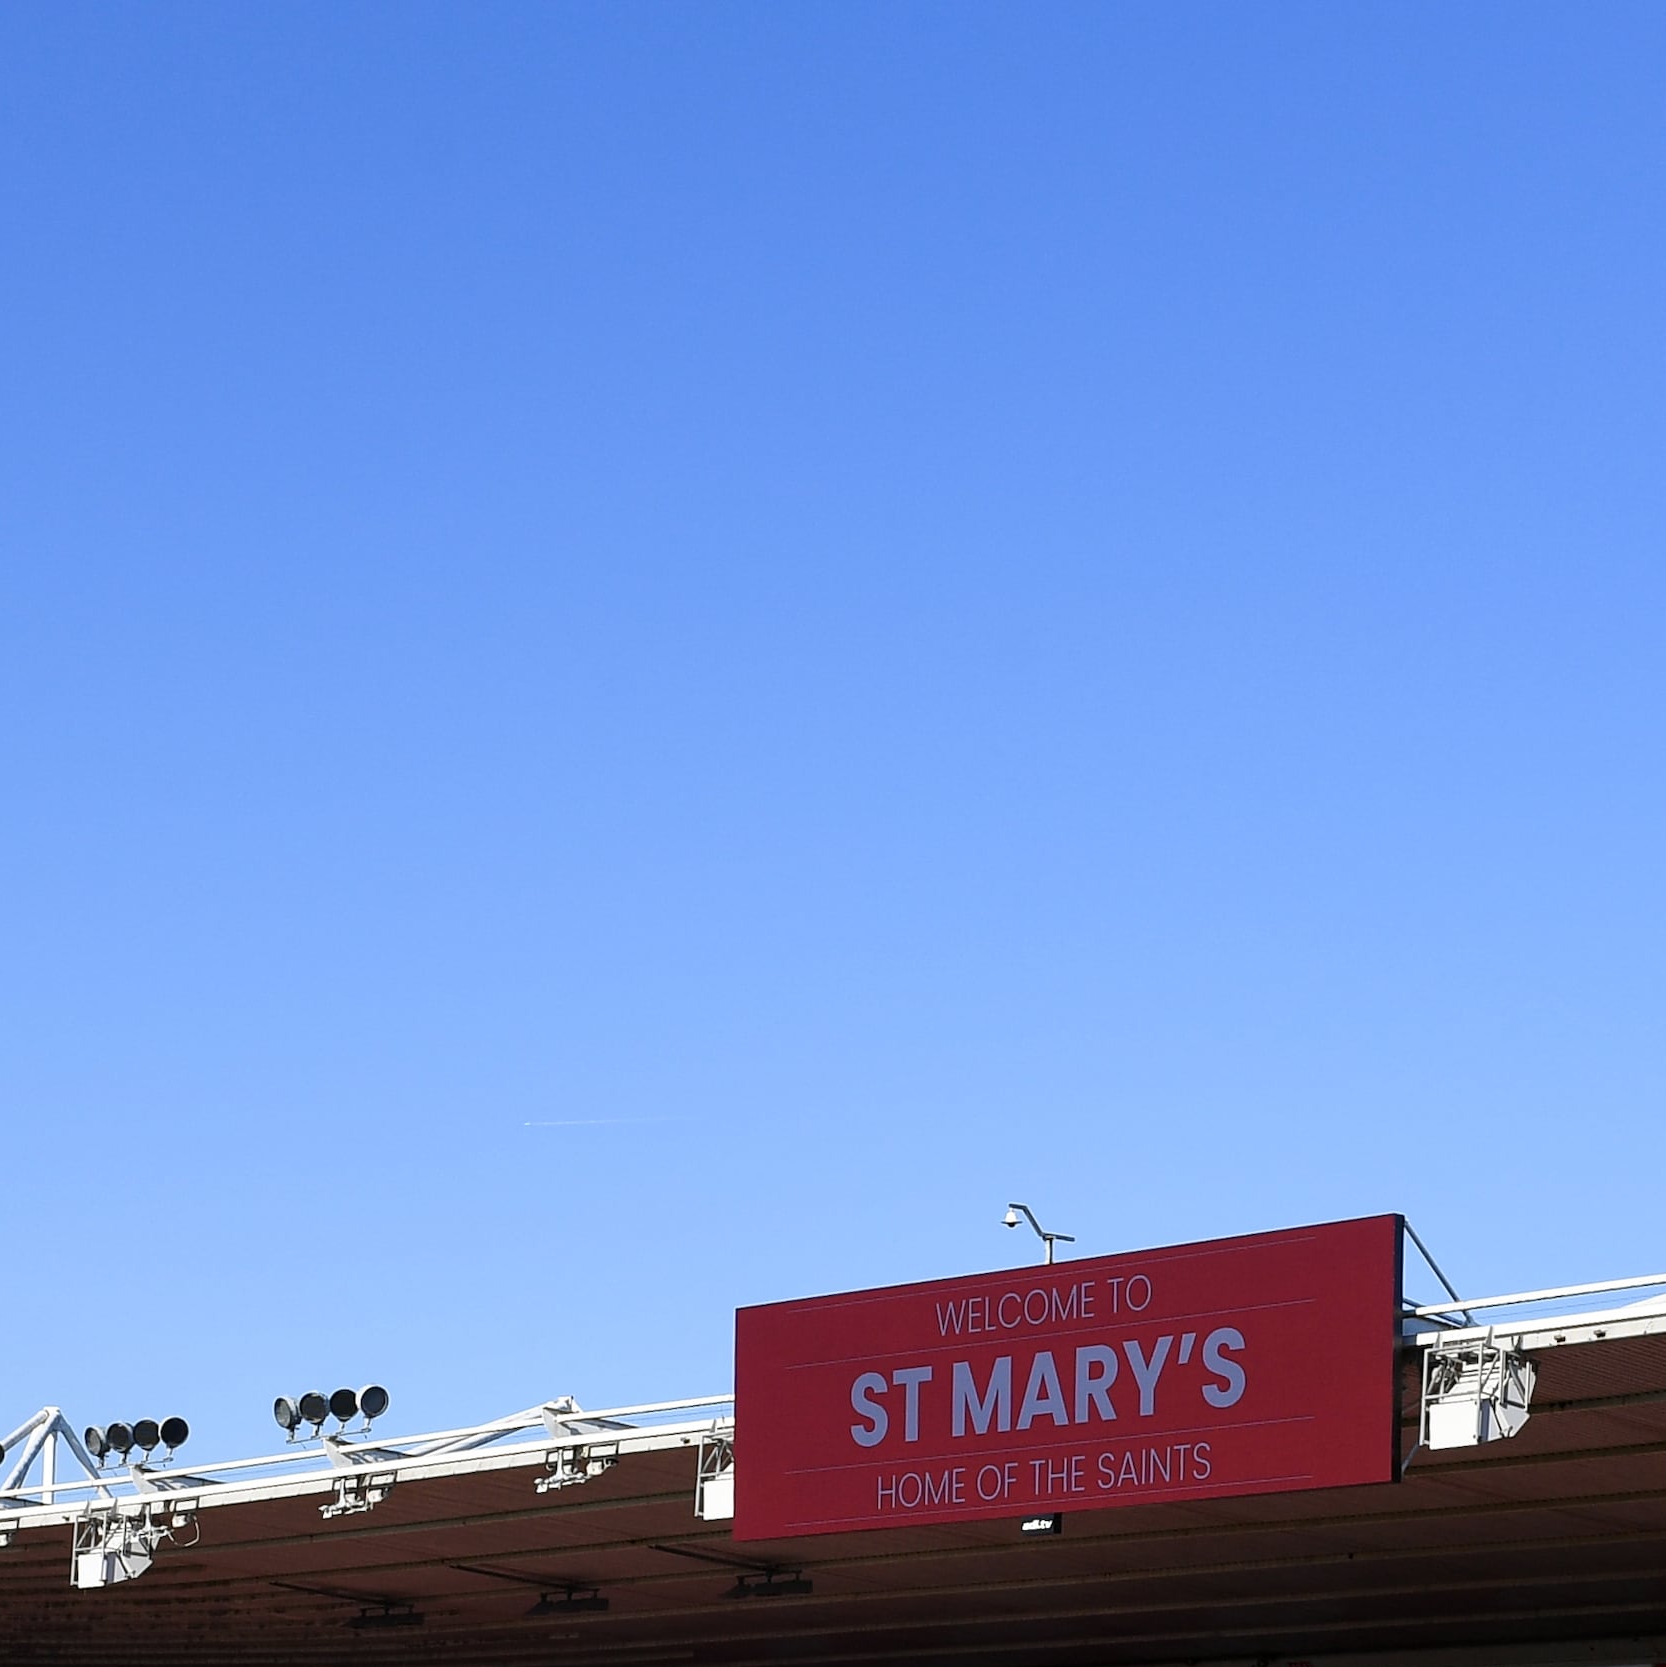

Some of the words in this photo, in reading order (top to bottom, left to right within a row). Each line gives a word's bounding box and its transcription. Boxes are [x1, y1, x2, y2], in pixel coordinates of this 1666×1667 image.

[936, 1281, 1095, 1337] WELCOME
[1106, 1274, 1153, 1313] TO
[850, 1365, 933, 1448] ST
[952, 1327, 1247, 1438] MARY'S
[877, 1467, 966, 1510] HOME
[977, 1461, 1019, 1501] OF
[1029, 1455, 1086, 1496] THE
[1097, 1442, 1211, 1490] SAINTS
